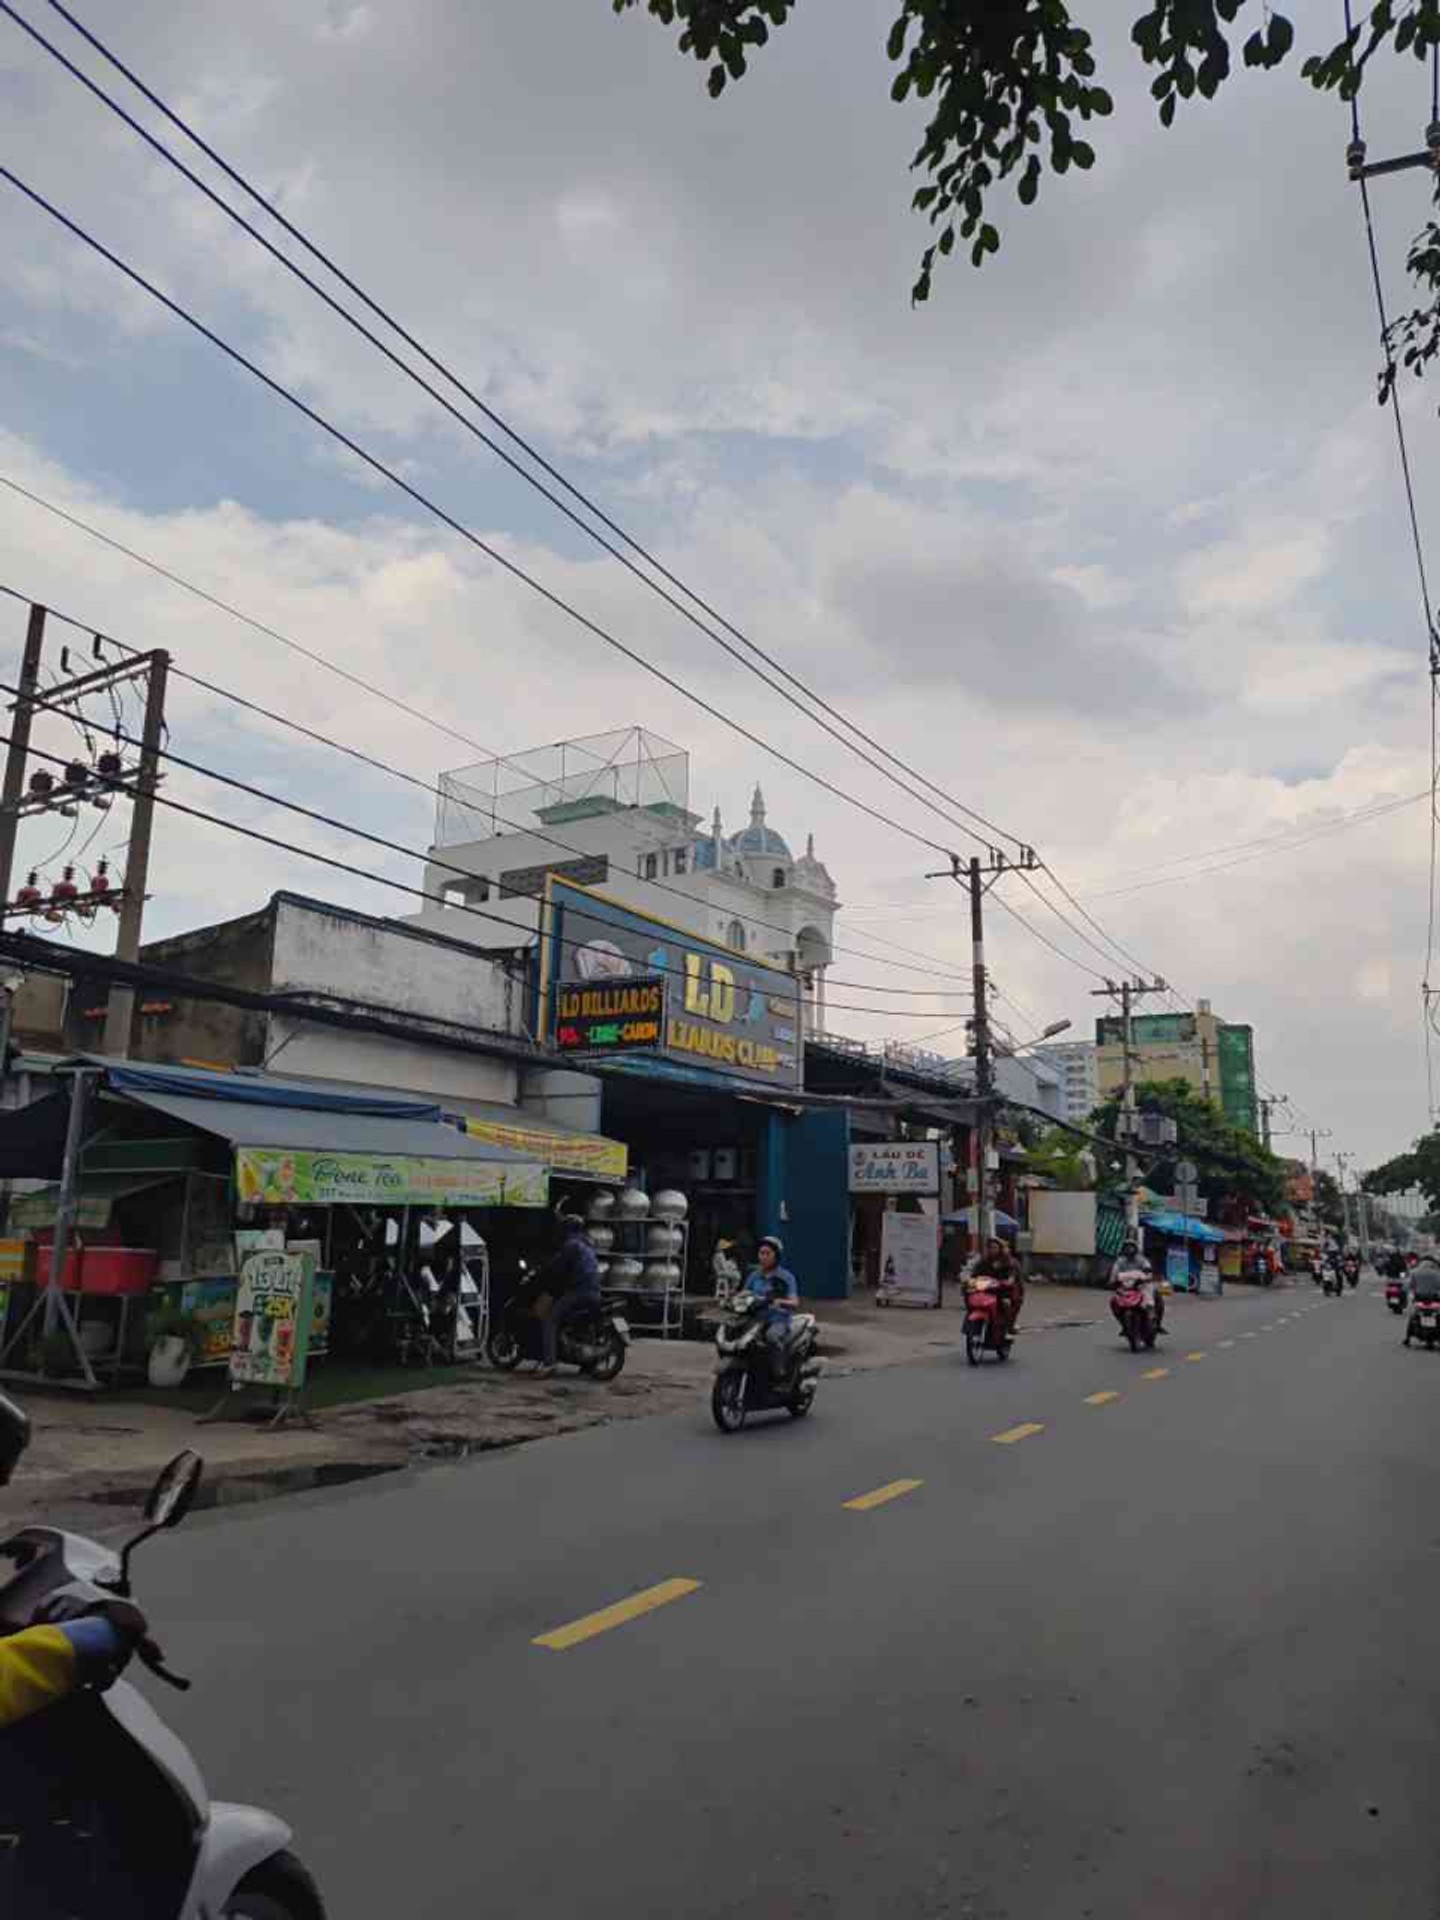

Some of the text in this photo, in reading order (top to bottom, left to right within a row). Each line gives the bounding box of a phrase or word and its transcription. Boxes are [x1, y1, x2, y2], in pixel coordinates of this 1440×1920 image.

[561, 986, 660, 1018] LD BILLIARDS
[684, 953, 734, 1024] LD
[855, 1160, 929, 1180] Anh Ba
